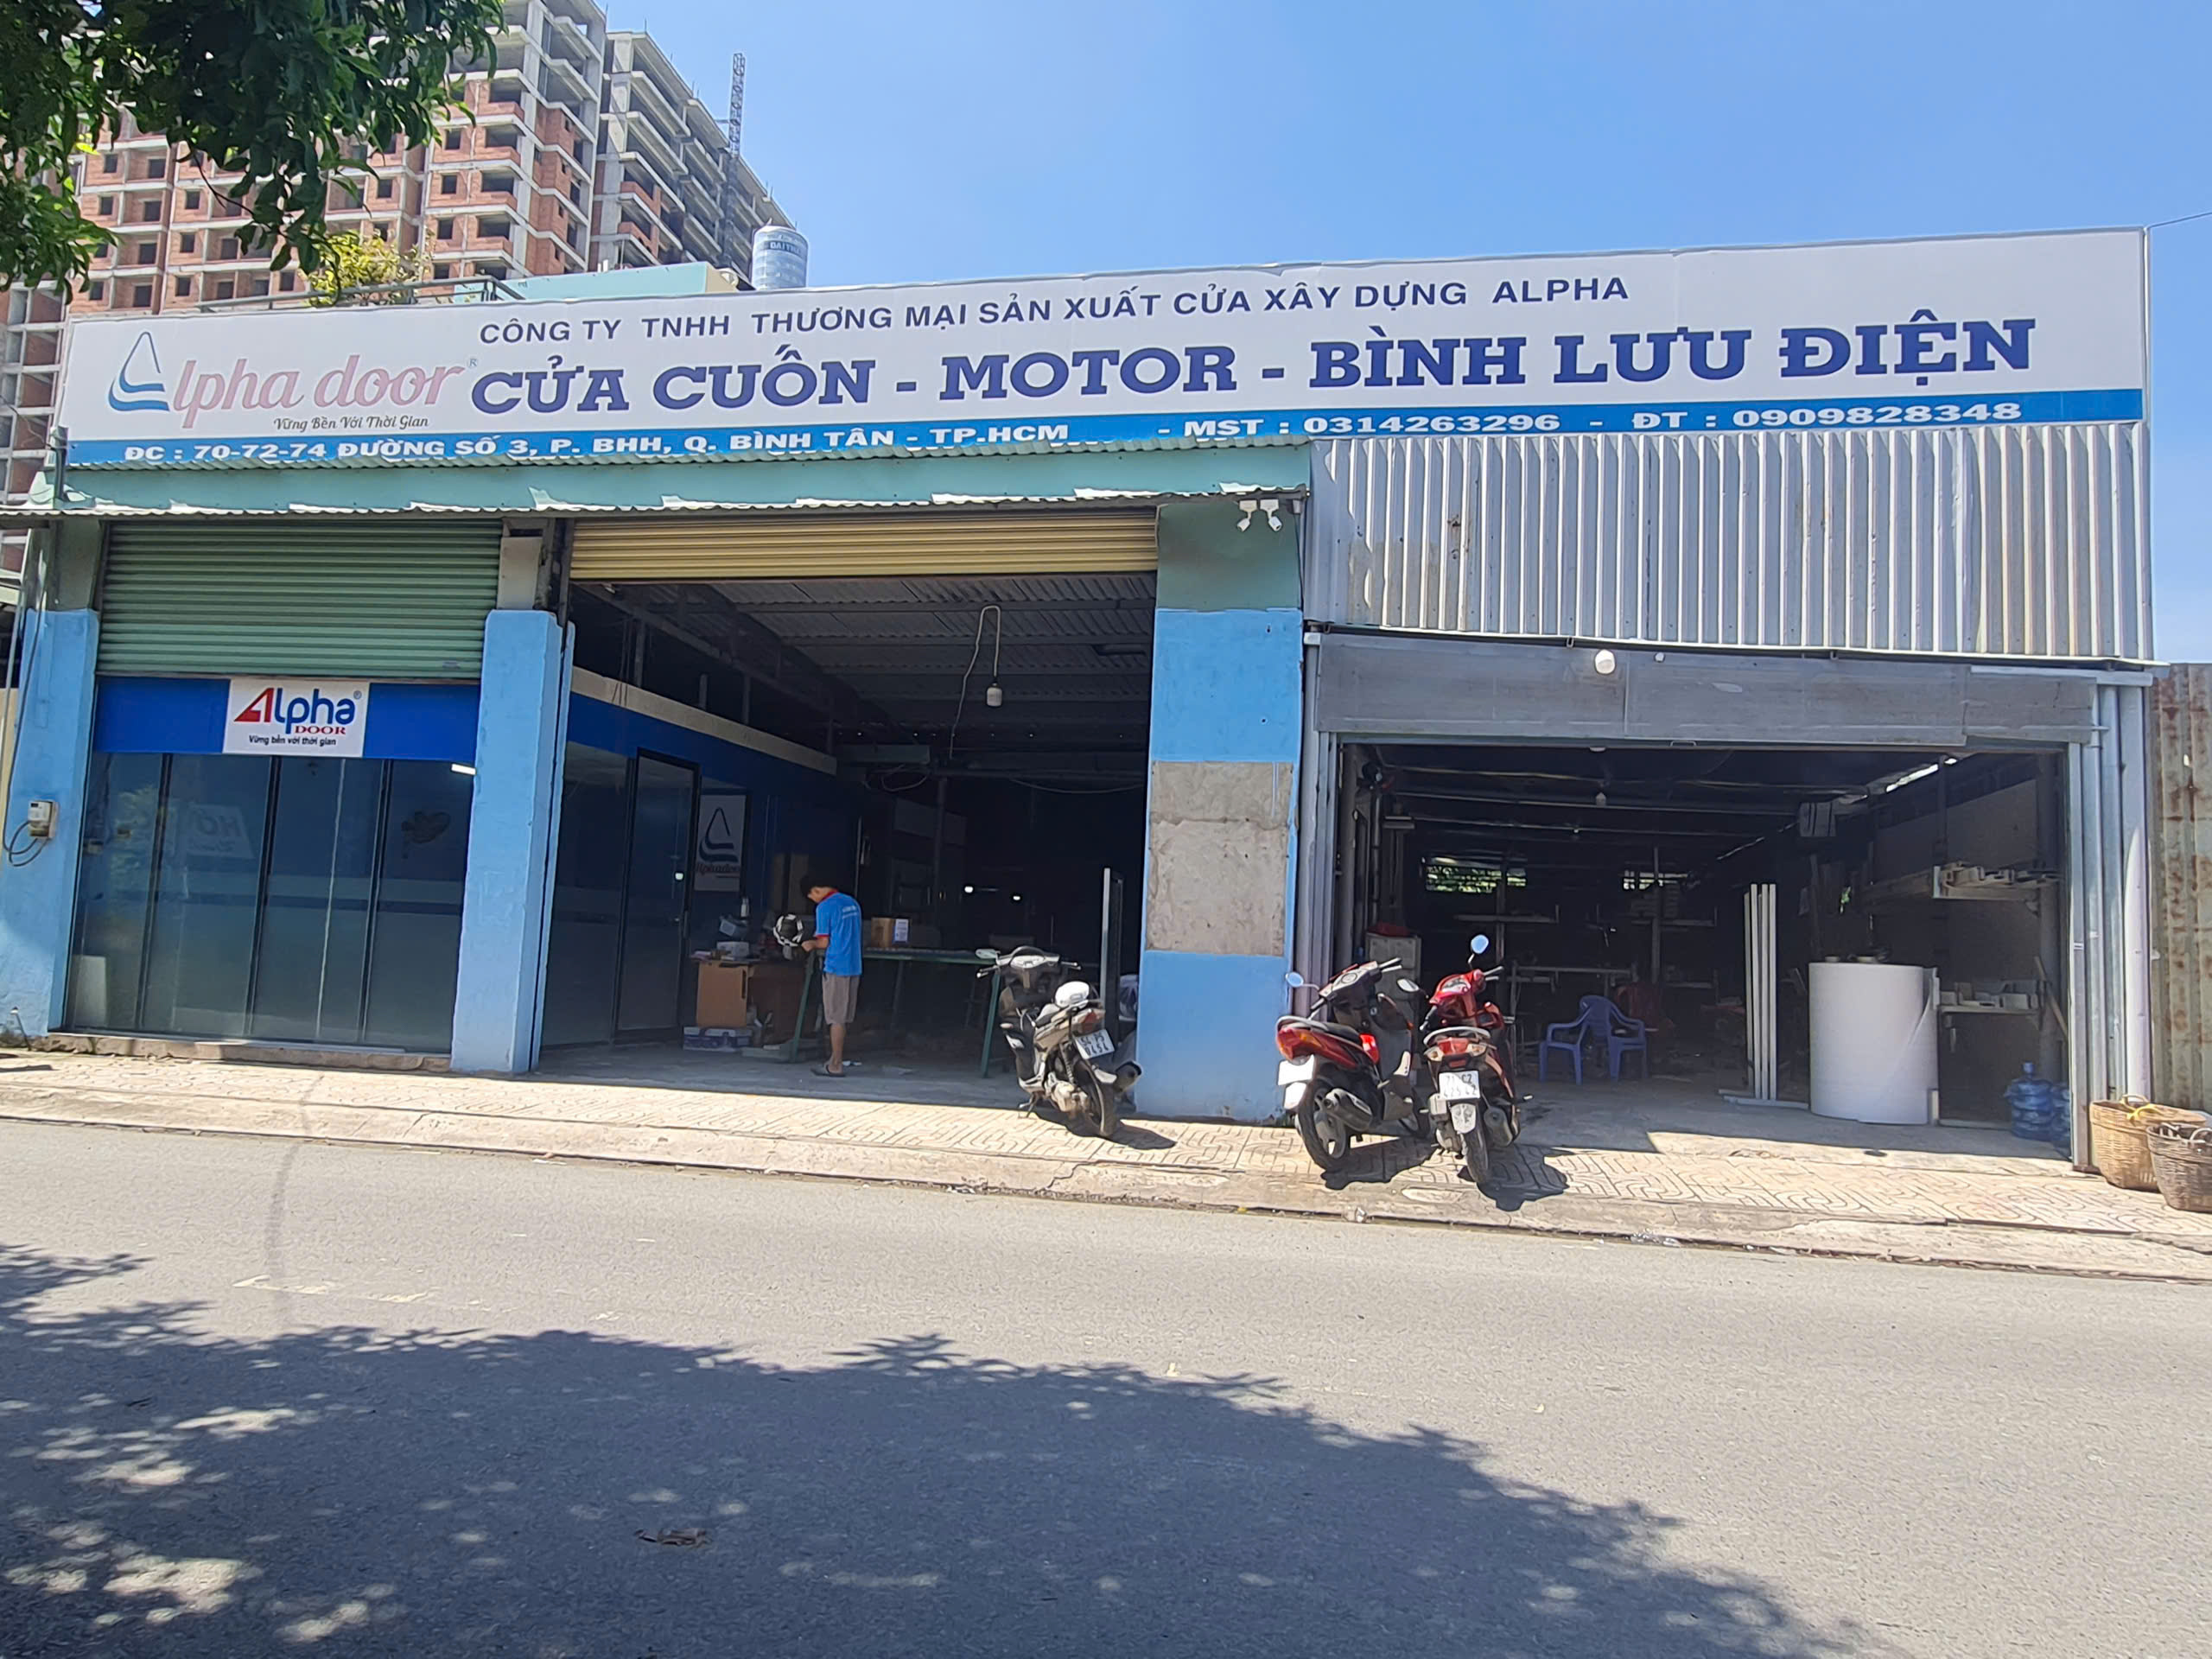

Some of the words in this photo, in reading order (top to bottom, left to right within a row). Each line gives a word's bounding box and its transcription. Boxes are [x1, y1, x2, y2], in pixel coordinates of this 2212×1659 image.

[480, 317, 570, 344] CÔNG
[582, 319, 621, 340] TY
[641, 315, 729, 338] TNHH
[751, 306, 892, 334] THƯƠNG
[905, 303, 966, 330] MẠI
[978, 292, 1051, 324] SẢN
[1063, 285, 1161, 320] XUẤT
[1173, 283, 1251, 315] CỬA
[1263, 282, 1341, 311] XÂY
[1355, 281, 1466, 311] DỰNG
[1491, 276, 1629, 304] ALPHA
[471, 354, 630, 415] CỬA
[652, 344, 876, 410] CUỐN
[939, 346, 1237, 401] MOTOR
[1309, 325, 1527, 388] BÌNH
[1553, 326, 1752, 384] LƯU
[1778, 308, 2037, 386] ĐIỆN
[124, 446, 165, 461] ĐC
[194, 443, 327, 460] 70-72-74
[338, 438, 445, 457] ĐƯỜNG
[454, 435, 500, 455] SỐ
[508, 439, 538, 456] 3,
[550, 439, 580, 454] P.
[593, 436, 671, 454] BHH,
[683, 435, 716, 452] Q.
[729, 431, 813, 450] BÌNH
[823, 428, 894, 447] TÂN
[930, 425, 1070, 444] TP.HCM
[1184, 419, 1264, 436] MST
[1303, 414, 1560, 434] 0314263296
[1632, 411, 1688, 429] ĐT
[1732, 403, 2023, 428] 0909828348
[273, 418, 308, 433] Vững
[311, 416, 336, 429] Bền
[340, 416, 363, 429] Với
[365, 415, 397, 428] Thời
[234, 688, 356, 734] Alpha
[295, 725, 346, 734] DOOR
